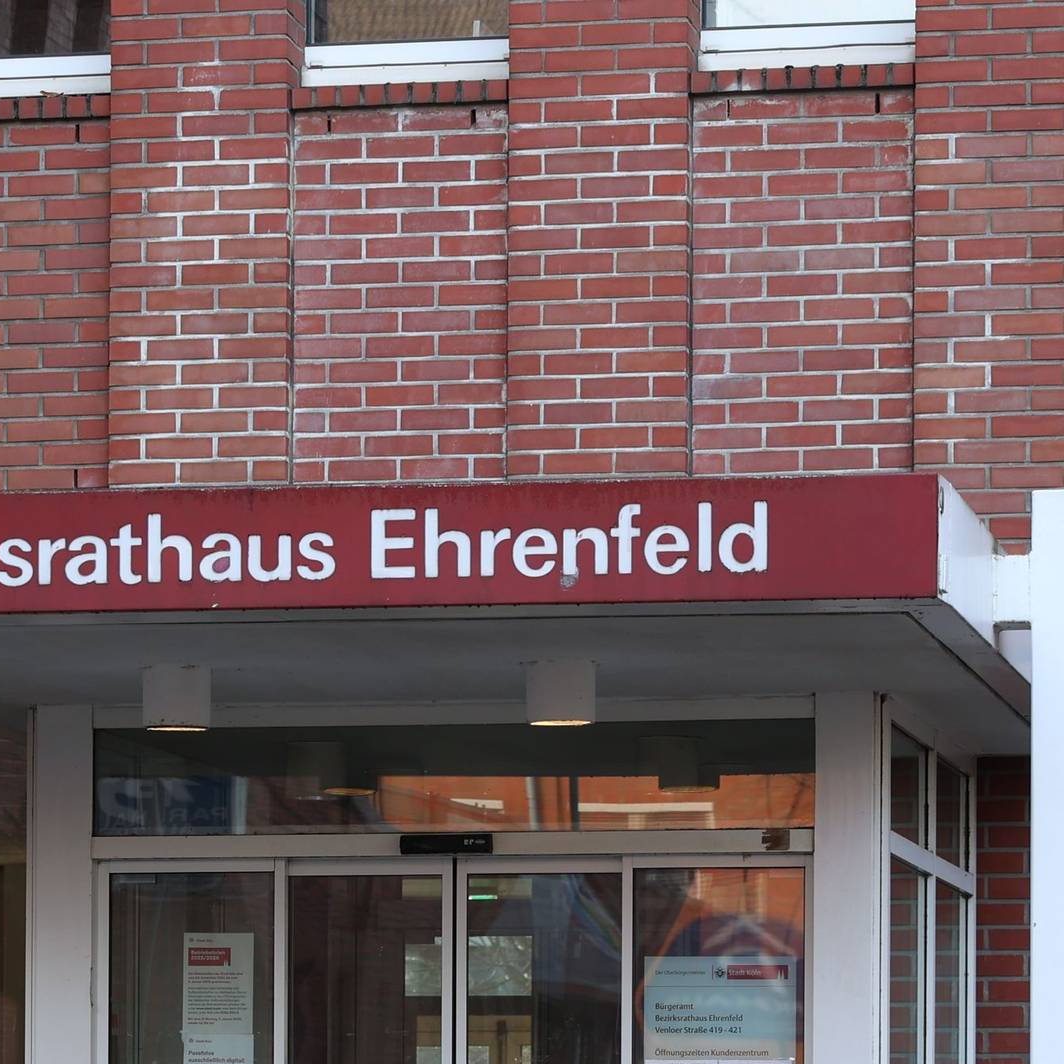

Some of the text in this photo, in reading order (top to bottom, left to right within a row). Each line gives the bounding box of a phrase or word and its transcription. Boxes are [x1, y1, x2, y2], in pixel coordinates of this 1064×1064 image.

[370, 500, 769, 580] Ehrenfeld
[655, 1002, 694, 1011] Bürgeramt
[655, 1014, 743, 1022] Bezirksrathaus Ehrenfeld
[655, 1026, 682, 1034] Venloer
[684, 1026, 707, 1034] Straße
[709, 1026, 723, 1034] 419
[728, 1026, 742, 1034] 421
[654, 1048, 769, 1058] Öffnungszeiten Kundenzentrum
